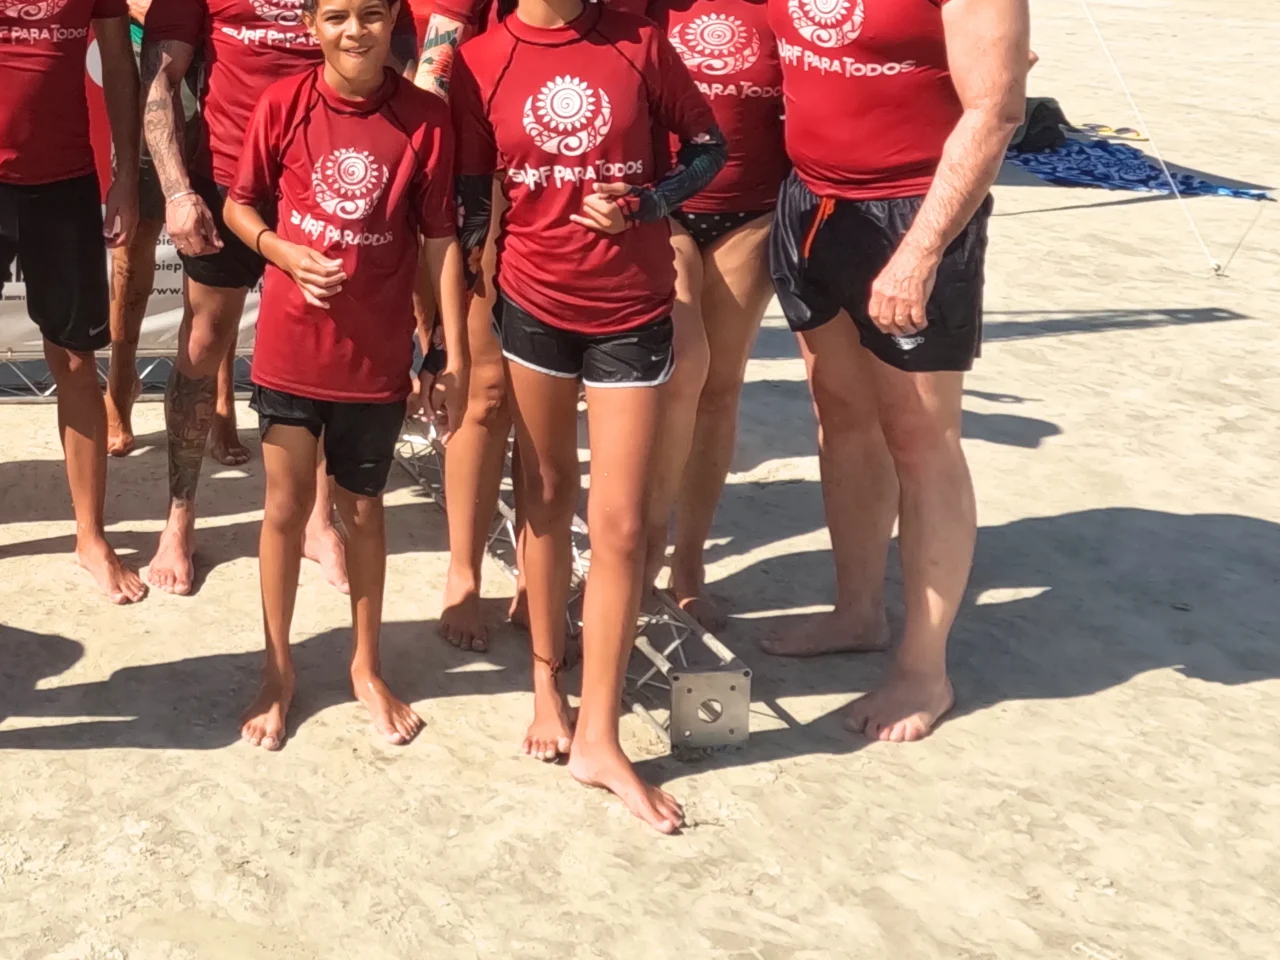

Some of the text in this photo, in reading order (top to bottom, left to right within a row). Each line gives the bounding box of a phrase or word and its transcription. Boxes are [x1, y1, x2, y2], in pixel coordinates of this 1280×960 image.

[11, 26, 50, 44] PARA
[778, 37, 916, 78] URF PARA TODOS
[694, 80, 781, 100] ARA TODO
[508, 159, 642, 191] SURF PARA TODOS
